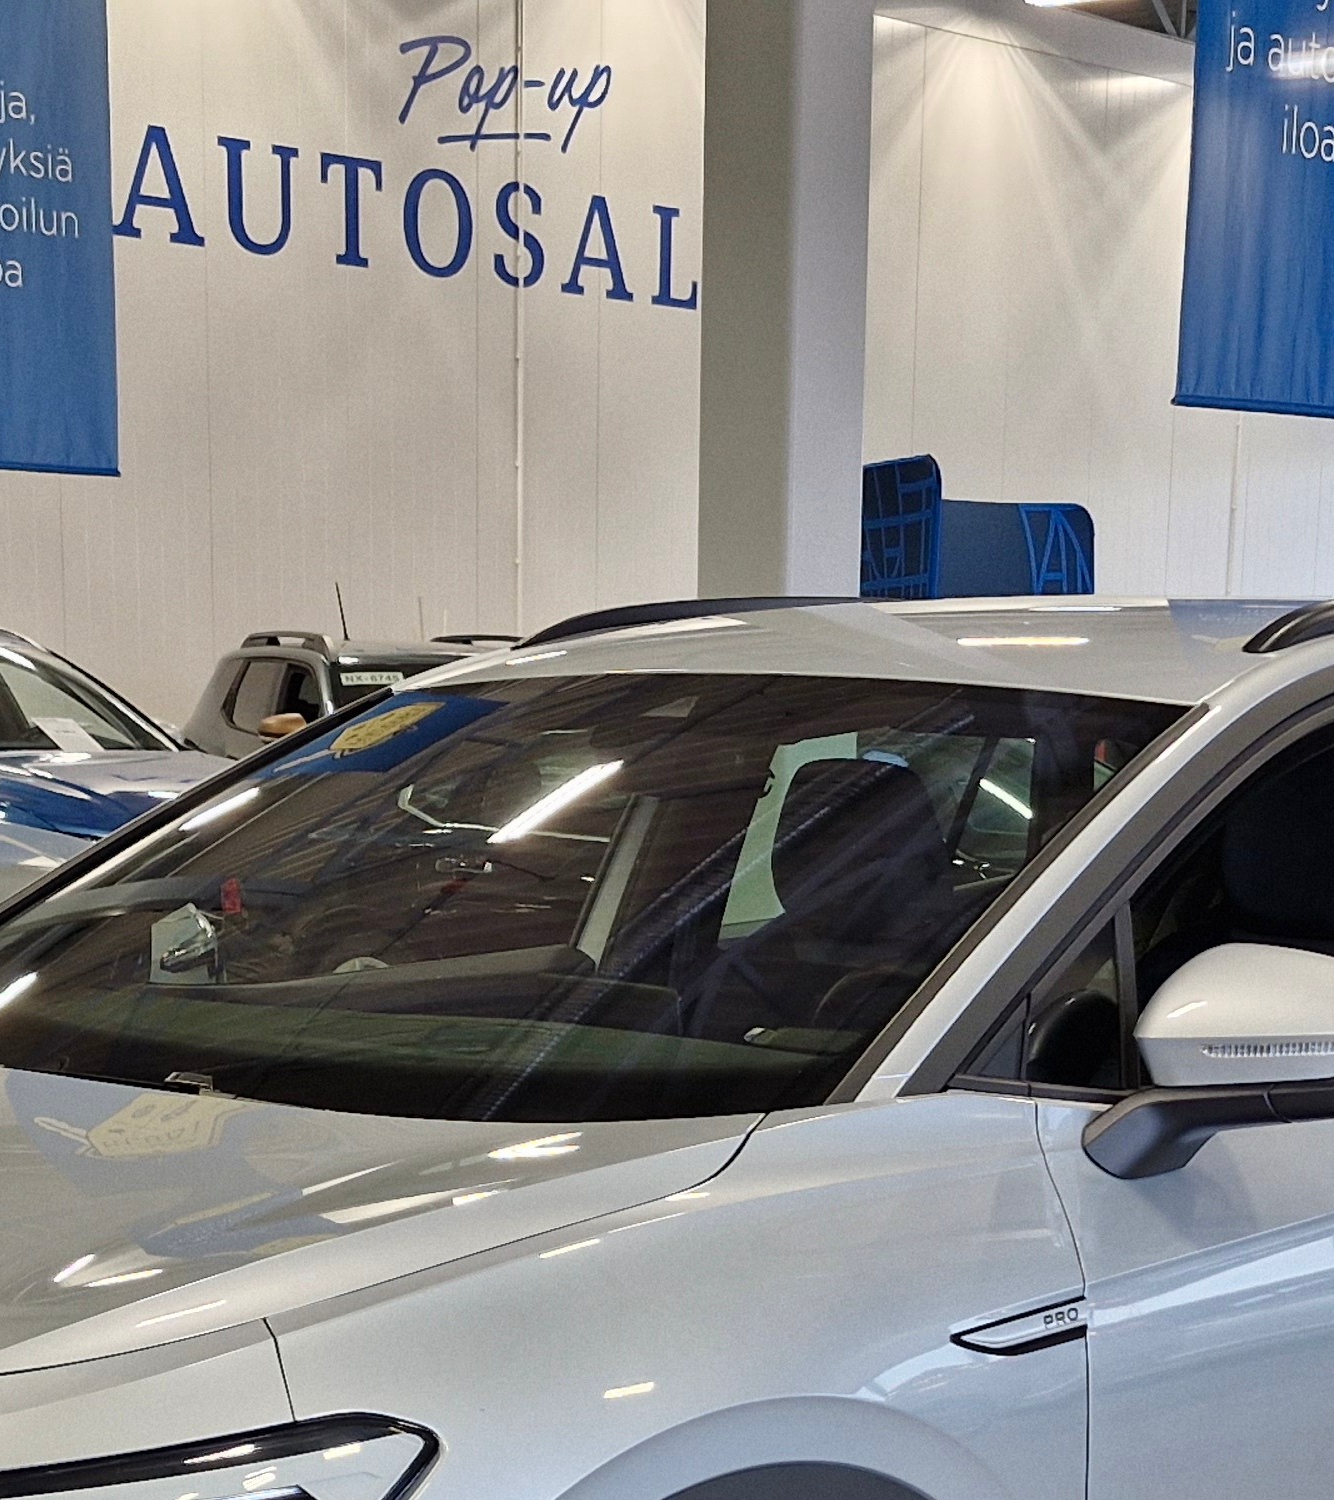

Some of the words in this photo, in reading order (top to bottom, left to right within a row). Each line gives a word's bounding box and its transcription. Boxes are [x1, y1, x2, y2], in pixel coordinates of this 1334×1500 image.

[1226, 11, 1255, 72] ja
[398, 33, 613, 153] Pop-up
[1043, 1307, 1079, 1330] PRO
